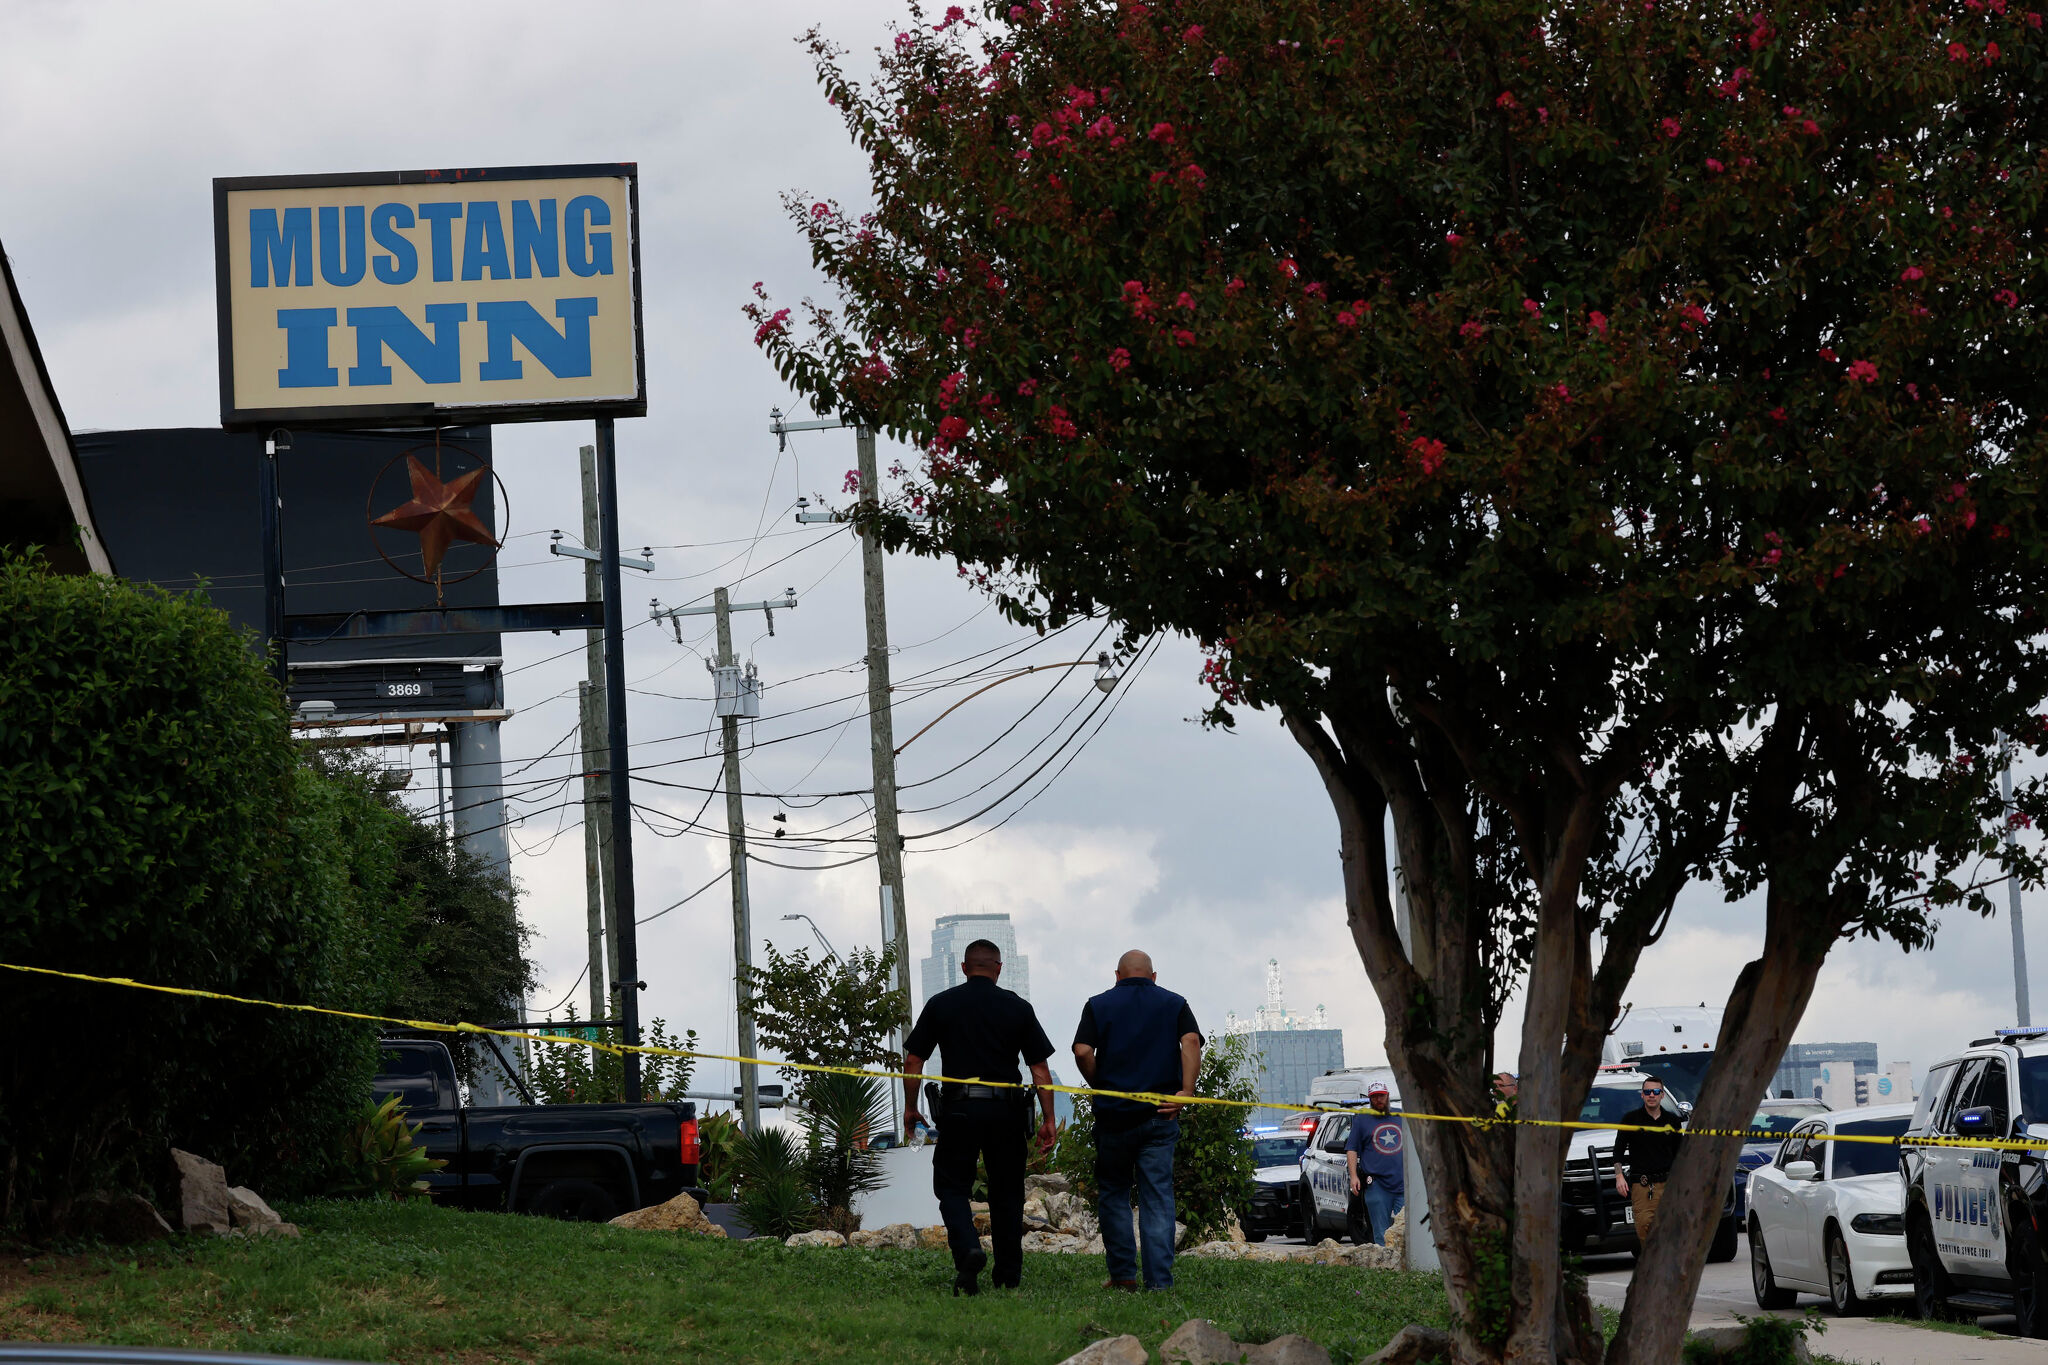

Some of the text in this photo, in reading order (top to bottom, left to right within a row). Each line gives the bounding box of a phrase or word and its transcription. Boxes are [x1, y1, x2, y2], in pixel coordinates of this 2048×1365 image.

[249, 195, 614, 288] MUSTANG
[277, 296, 598, 388] INN
[388, 684, 421, 696] 3869
[1934, 1183, 1989, 1227] POLICE
[1961, 1246, 1977, 1257] SINCE
